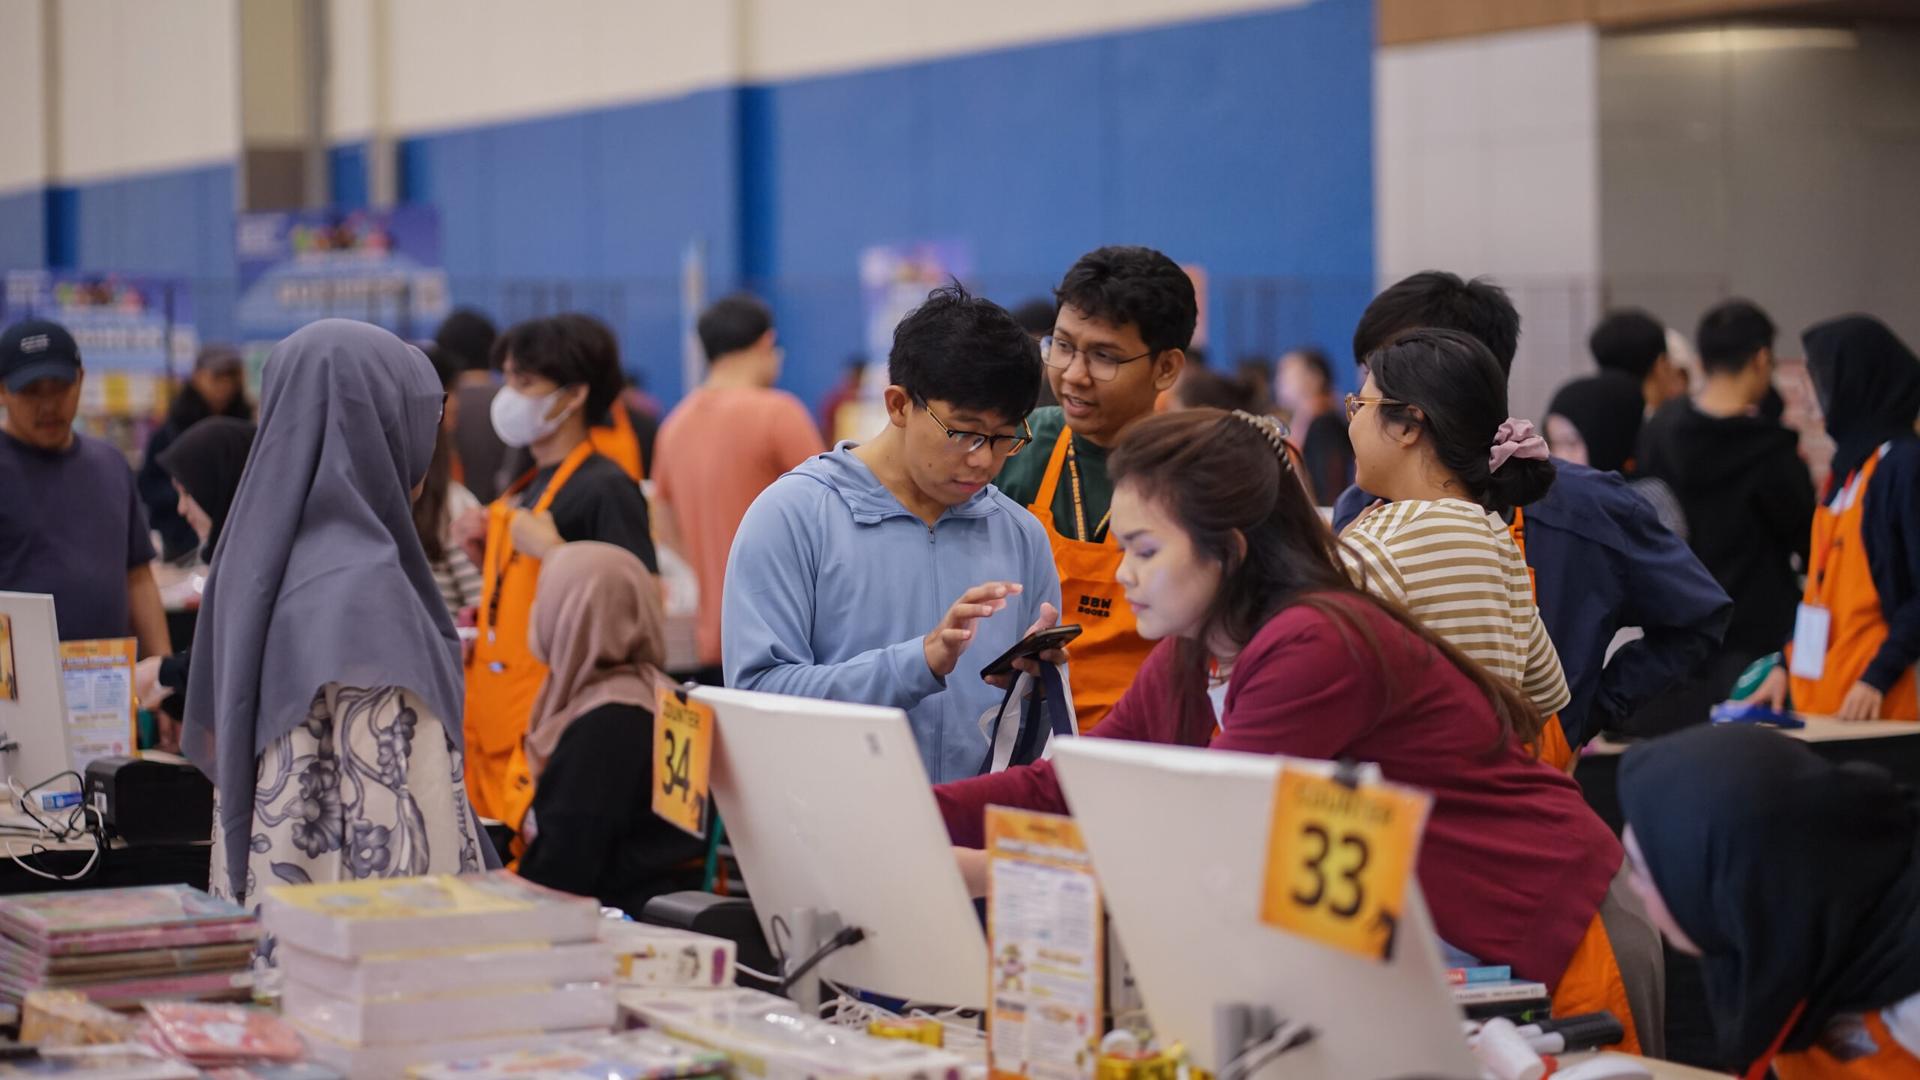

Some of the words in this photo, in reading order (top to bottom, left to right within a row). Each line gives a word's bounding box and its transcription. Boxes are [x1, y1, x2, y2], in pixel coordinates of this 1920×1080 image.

[1080, 595, 1112, 609] BBW
[662, 728, 691, 803] 34
[1289, 824, 1371, 919] 33
